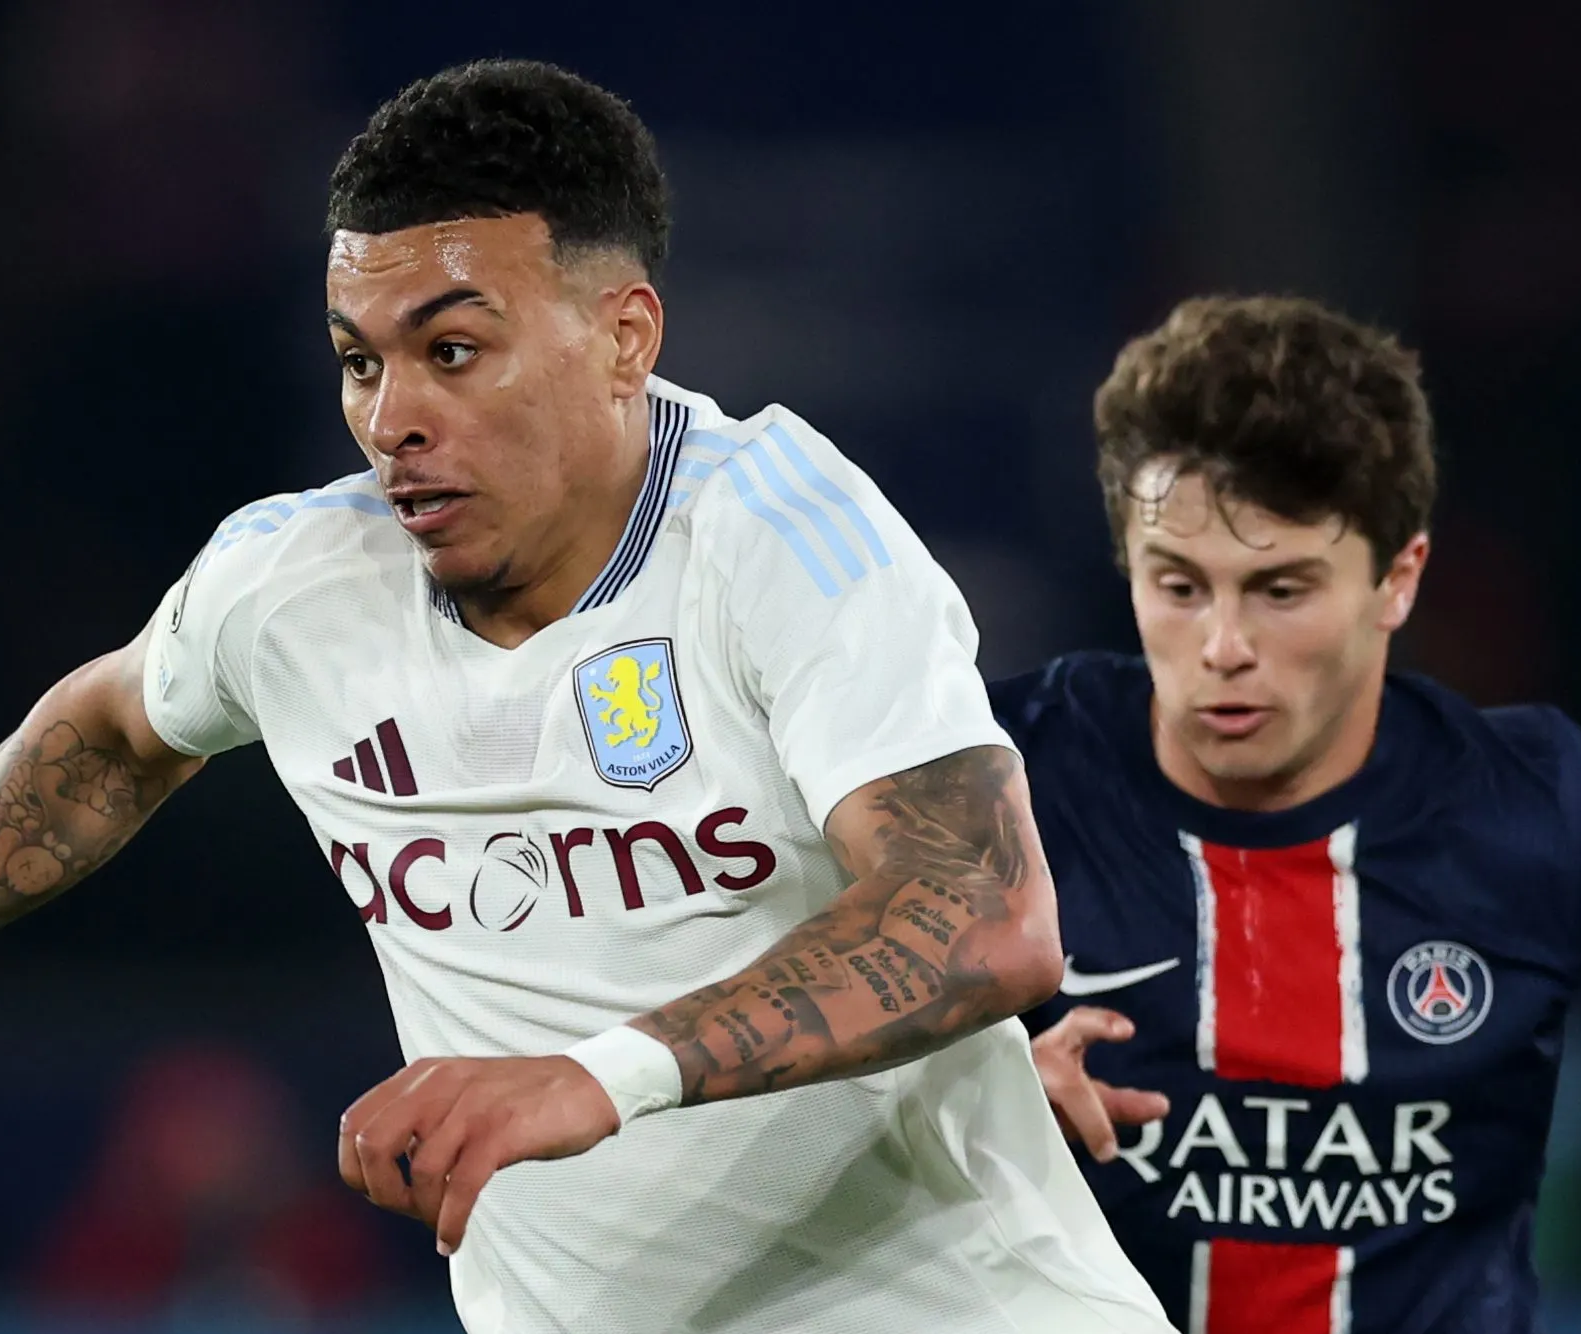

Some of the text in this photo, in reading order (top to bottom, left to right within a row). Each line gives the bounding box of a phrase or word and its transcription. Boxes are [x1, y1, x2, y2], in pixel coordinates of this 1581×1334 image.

[607, 744, 681, 777] ASTON VILLA
[331, 806, 777, 932] acorns
[1402, 946, 1471, 972] PARIS
[1167, 1168, 1457, 1231] AIRWAYS
